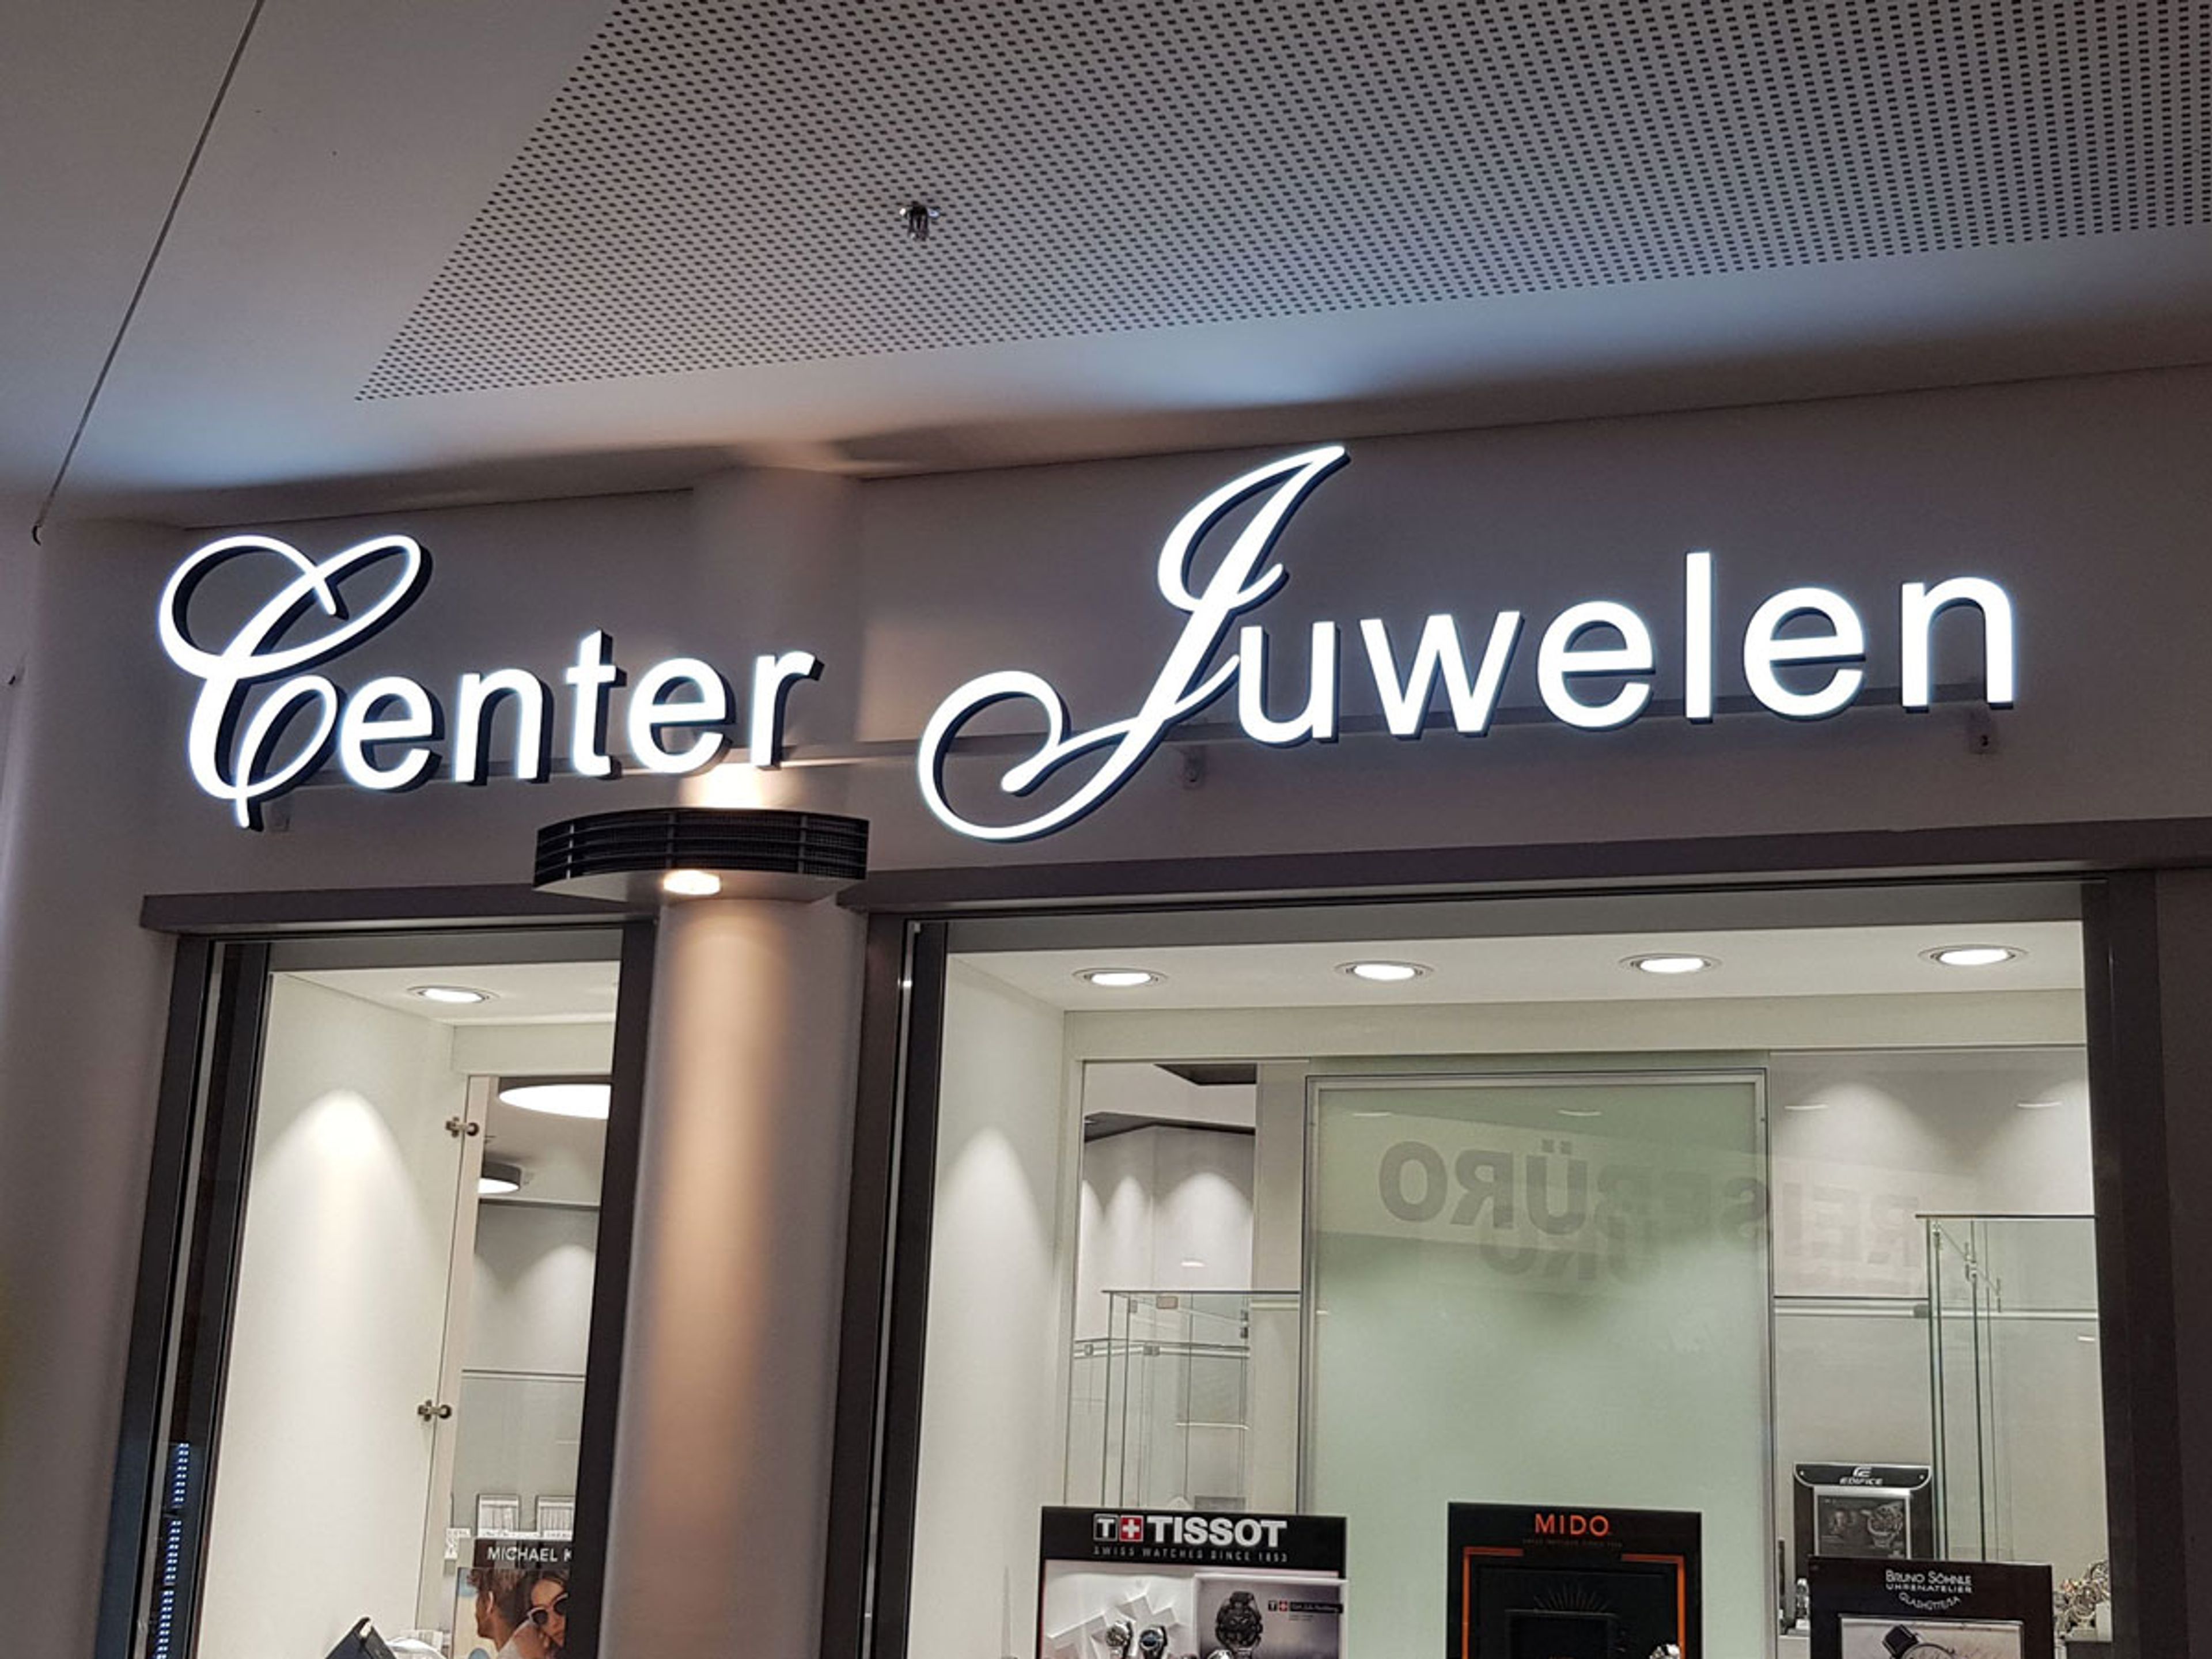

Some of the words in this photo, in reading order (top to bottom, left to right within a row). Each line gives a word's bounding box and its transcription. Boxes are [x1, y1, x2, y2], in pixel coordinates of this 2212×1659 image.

[157, 533, 820, 830] Center
[916, 445, 2015, 839] Juwelen
[1839, 1476, 1883, 1486] EDIFICE
[1147, 1516, 1287, 1547] TISSOT
[1535, 1513, 1609, 1536] MIDO
[487, 1546, 558, 1562] MICHAEL
[1094, 1546, 1135, 1556] SWISS
[1142, 1548, 1203, 1559] WATCHES
[1211, 1550, 1250, 1562] SINCE
[1885, 1569, 1925, 1584] BRUNO
